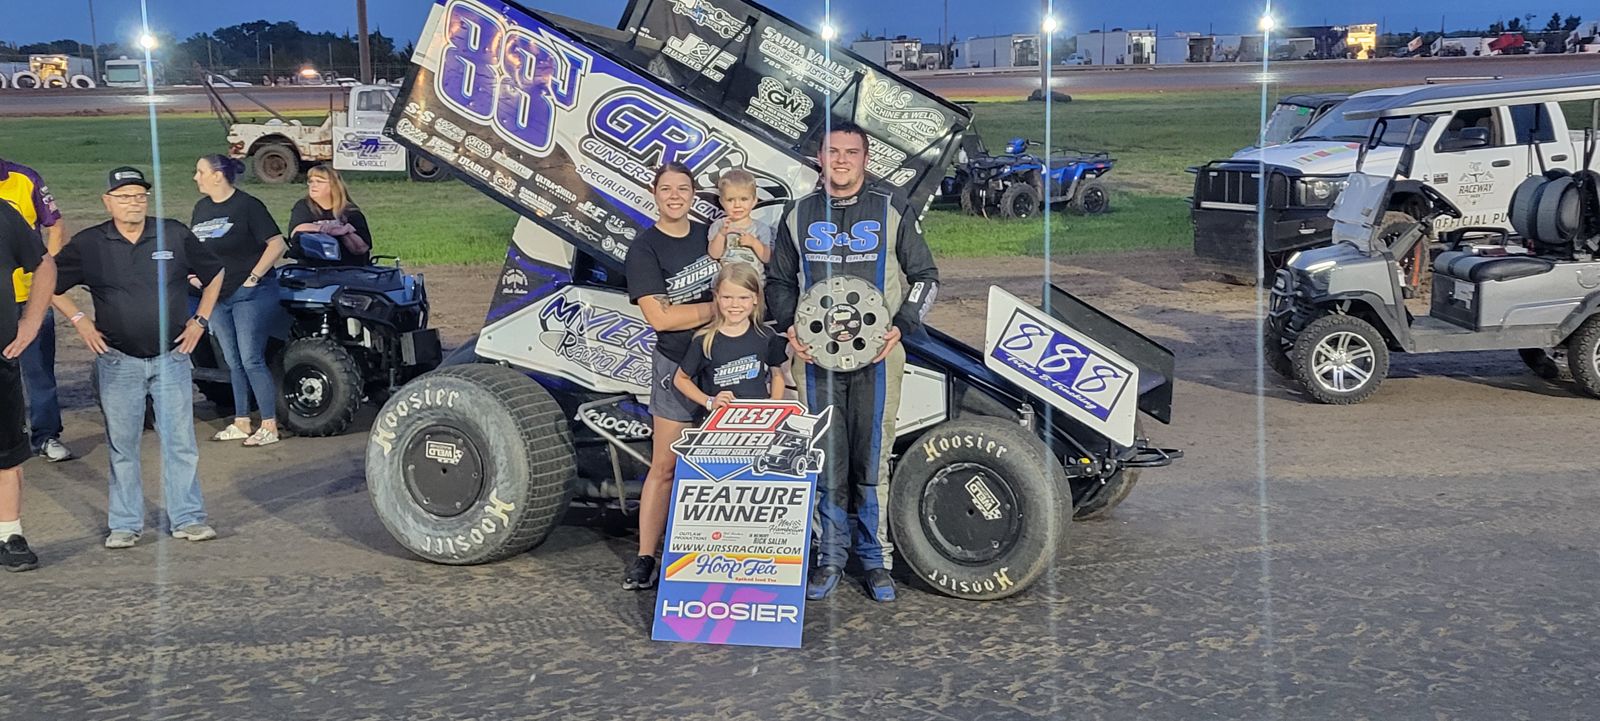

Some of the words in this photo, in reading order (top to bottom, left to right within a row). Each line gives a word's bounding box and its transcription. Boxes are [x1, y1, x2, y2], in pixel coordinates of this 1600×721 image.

[663, 48, 725, 80] AUTOMOIVE
[768, 90, 801, 113] GW
[870, 140, 903, 160] CKING
[458, 156, 491, 178] DIABLO
[582, 141, 656, 185] GUNDERS
[868, 161, 916, 186] UCKING
[577, 164, 641, 203] SPECIALIZING
[643, 200, 655, 211] IN
[1459, 183, 1493, 194] RACEWAY
[691, 196, 725, 220] ACIN
[1435, 214, 1487, 229] OFFICIAL
[1492, 212, 1508, 224] PU
[805, 220, 881, 252] S&S
[805, 253, 842, 263] TRAILER
[846, 253, 878, 262] SALES
[672, 263, 719, 290] HUISH
[540, 296, 658, 356] MYER
[556, 329, 617, 371] Racing
[612, 351, 652, 386] Eng
[719, 363, 754, 376] HUISH
[1004, 353, 1039, 376] Triple
[1052, 381, 1096, 410] Trucking
[371, 384, 460, 456] Hoosier
[701, 433, 776, 446] UNITED
[922, 433, 1007, 462] Hoosier
[680, 486, 806, 505] FEATURE
[969, 483, 995, 512] WELD
[420, 487, 515, 559] Hoosier
[683, 505, 788, 523] WINNER
[672, 543, 801, 555] WWW.URSSRACING.COM
[696, 554, 742, 579] Hoop
[743, 558, 778, 576] Tea
[928, 566, 1014, 593] Hoosier
[661, 600, 799, 623] HOOSIER
